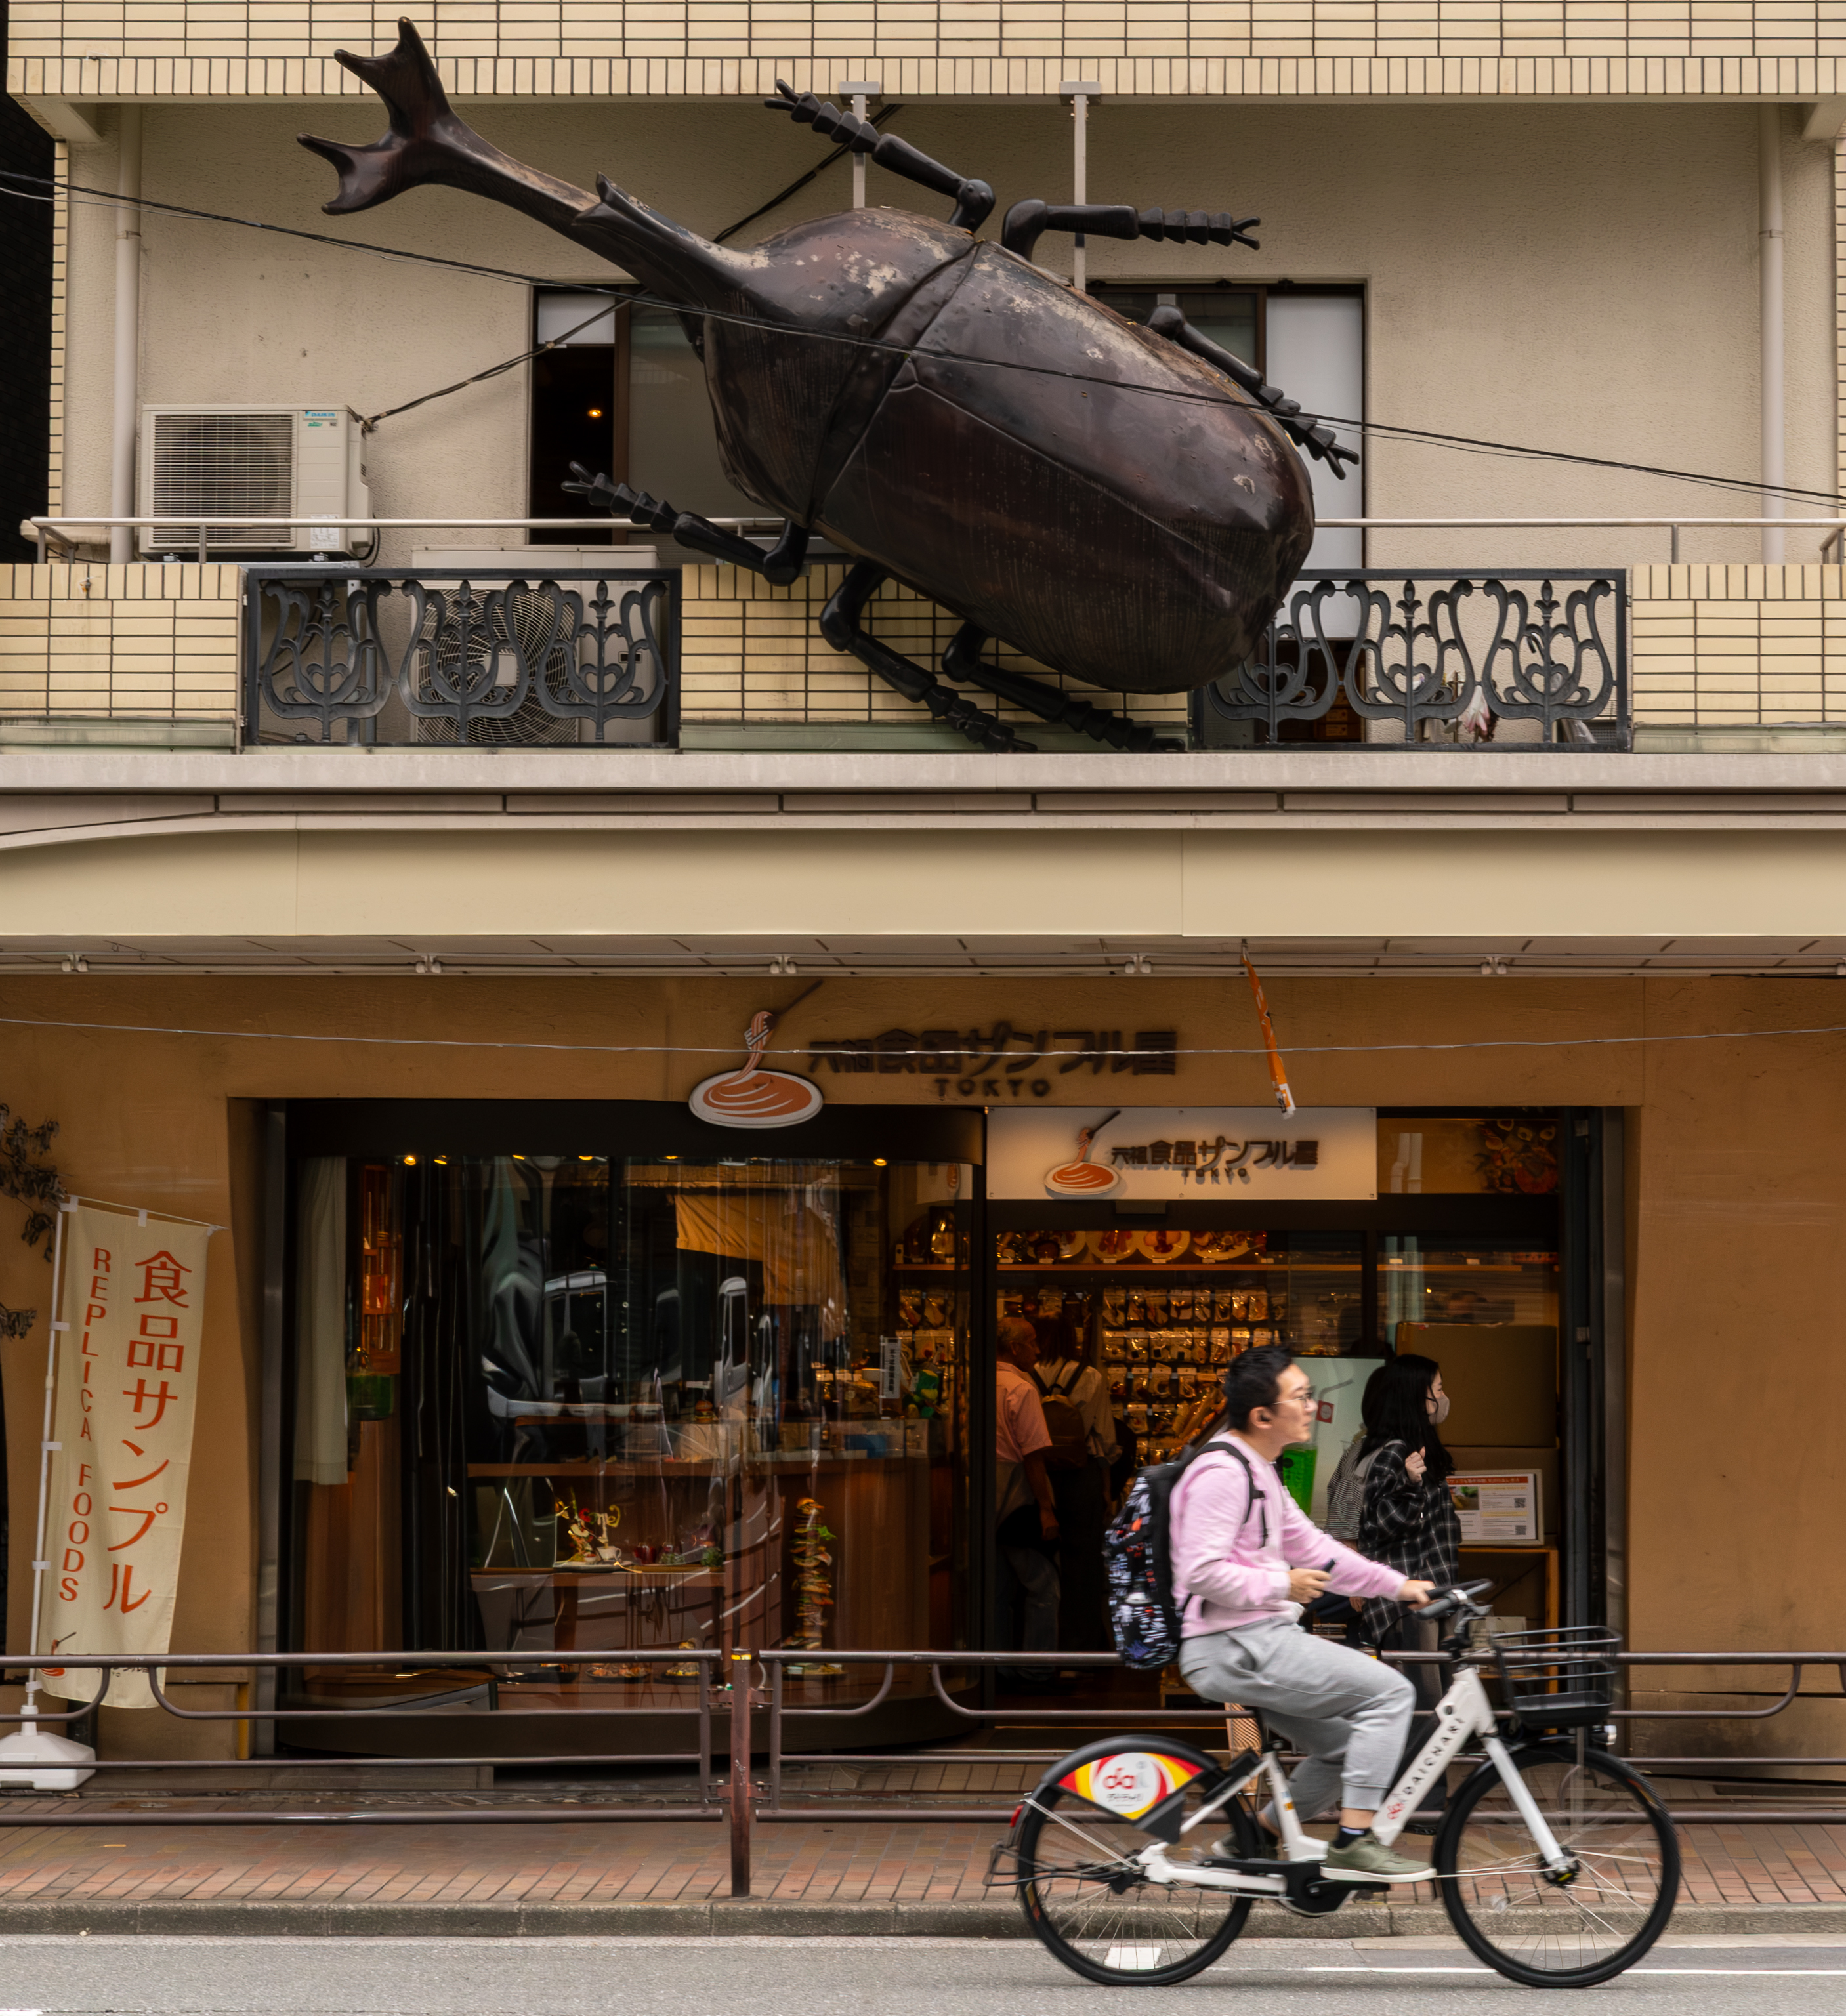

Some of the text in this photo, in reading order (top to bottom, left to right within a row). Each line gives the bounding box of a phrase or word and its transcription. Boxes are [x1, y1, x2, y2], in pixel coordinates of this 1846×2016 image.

[934, 1078, 1051, 1097] TOKYO
[1182, 1167, 1249, 1181] TOKYO
[59, 1247, 112, 1602] REPLICA FOODS
[102, 1250, 193, 1614] 食品サンプル
[1103, 1761, 1150, 1790] dai
[1402, 1717, 1466, 1797] DAICHARI
